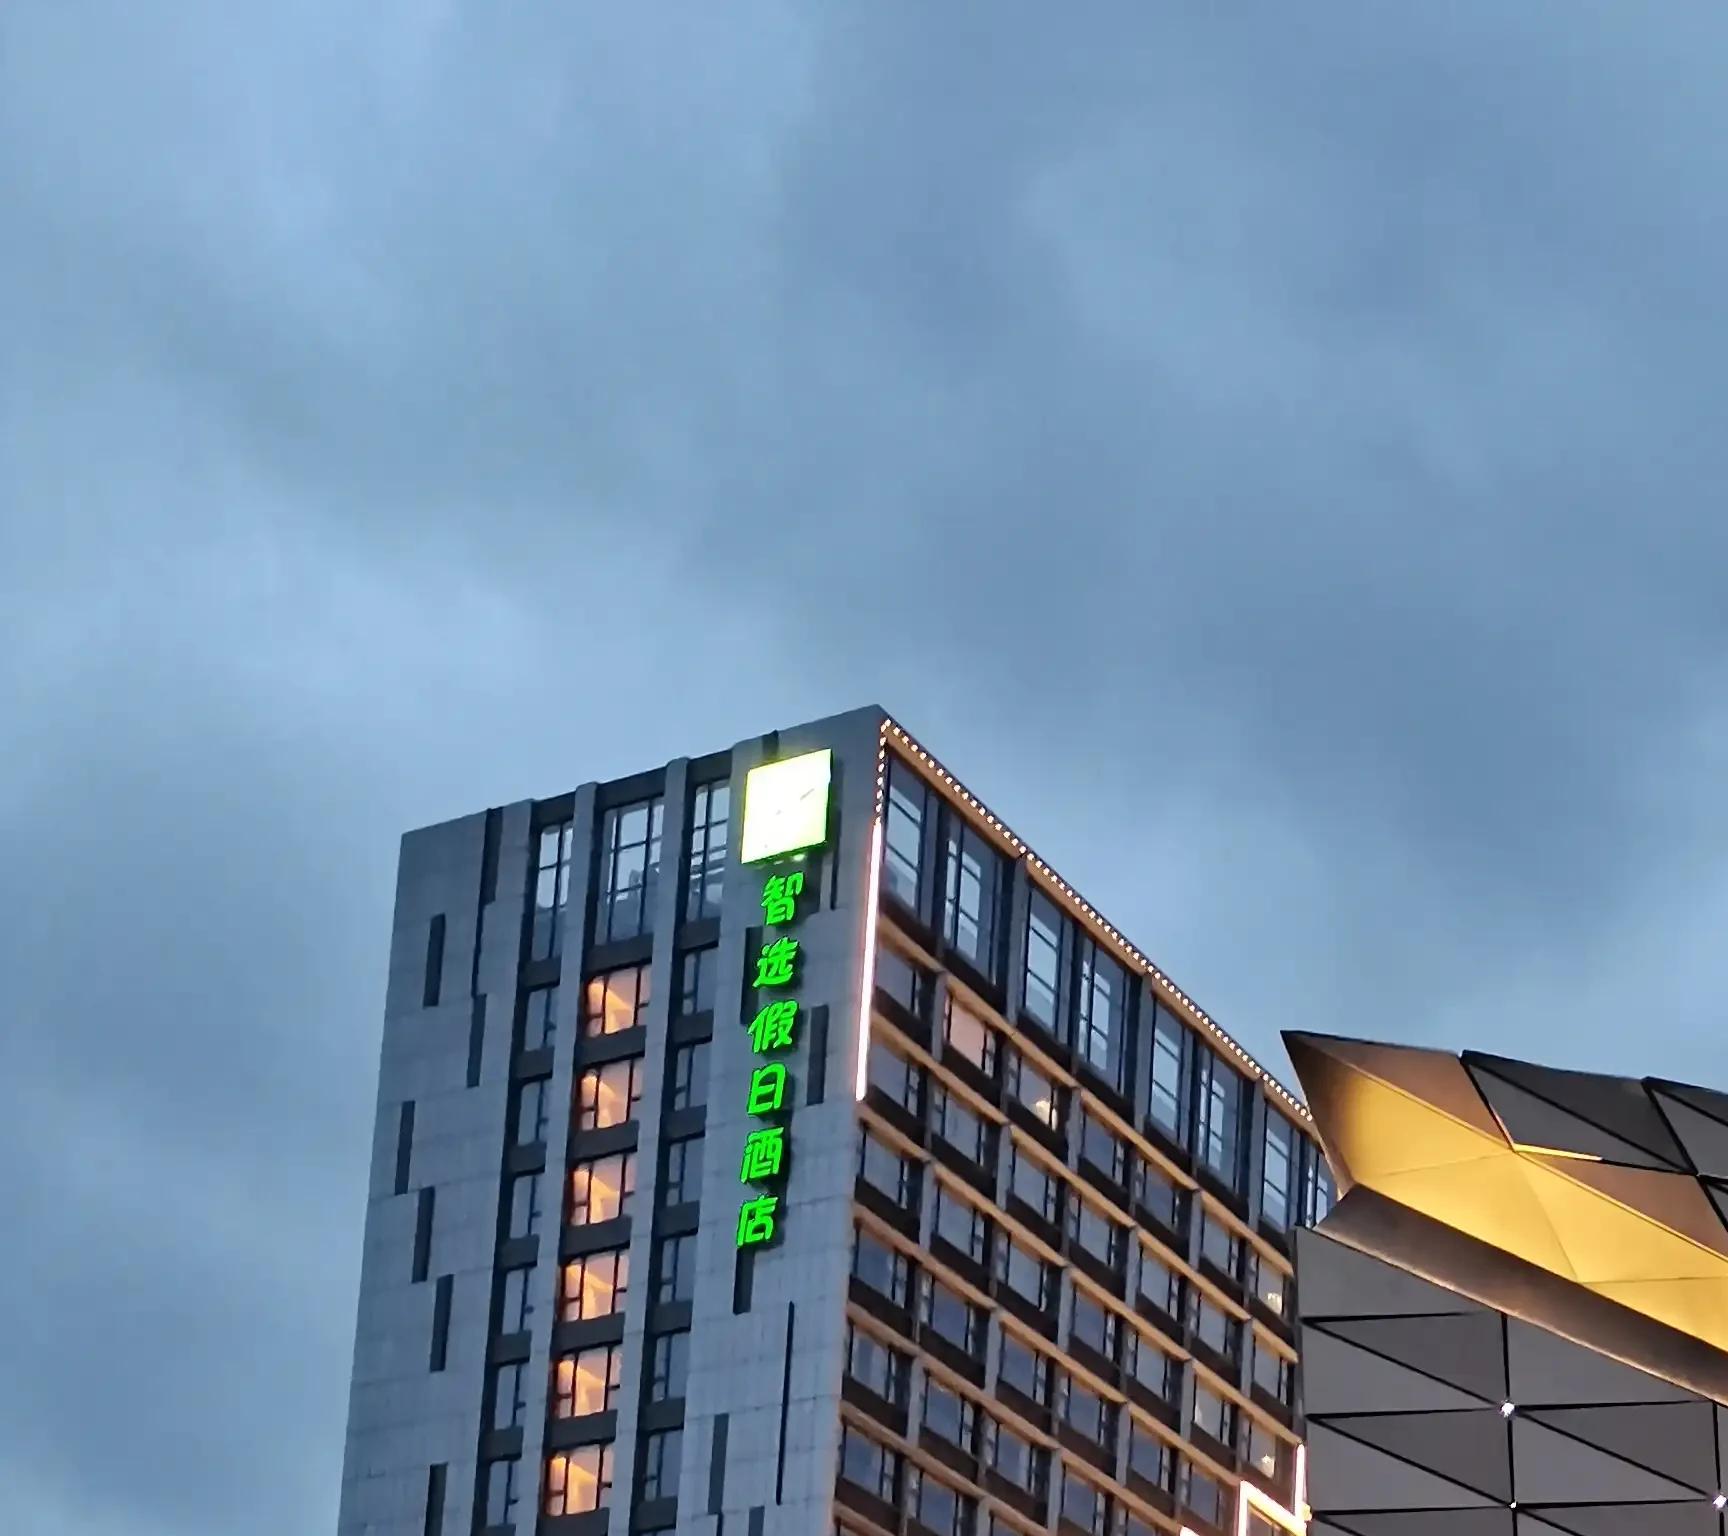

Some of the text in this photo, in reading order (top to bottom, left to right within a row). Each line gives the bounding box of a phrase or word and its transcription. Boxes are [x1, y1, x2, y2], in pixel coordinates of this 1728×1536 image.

[736, 871, 804, 1247] 智选假日酒店
